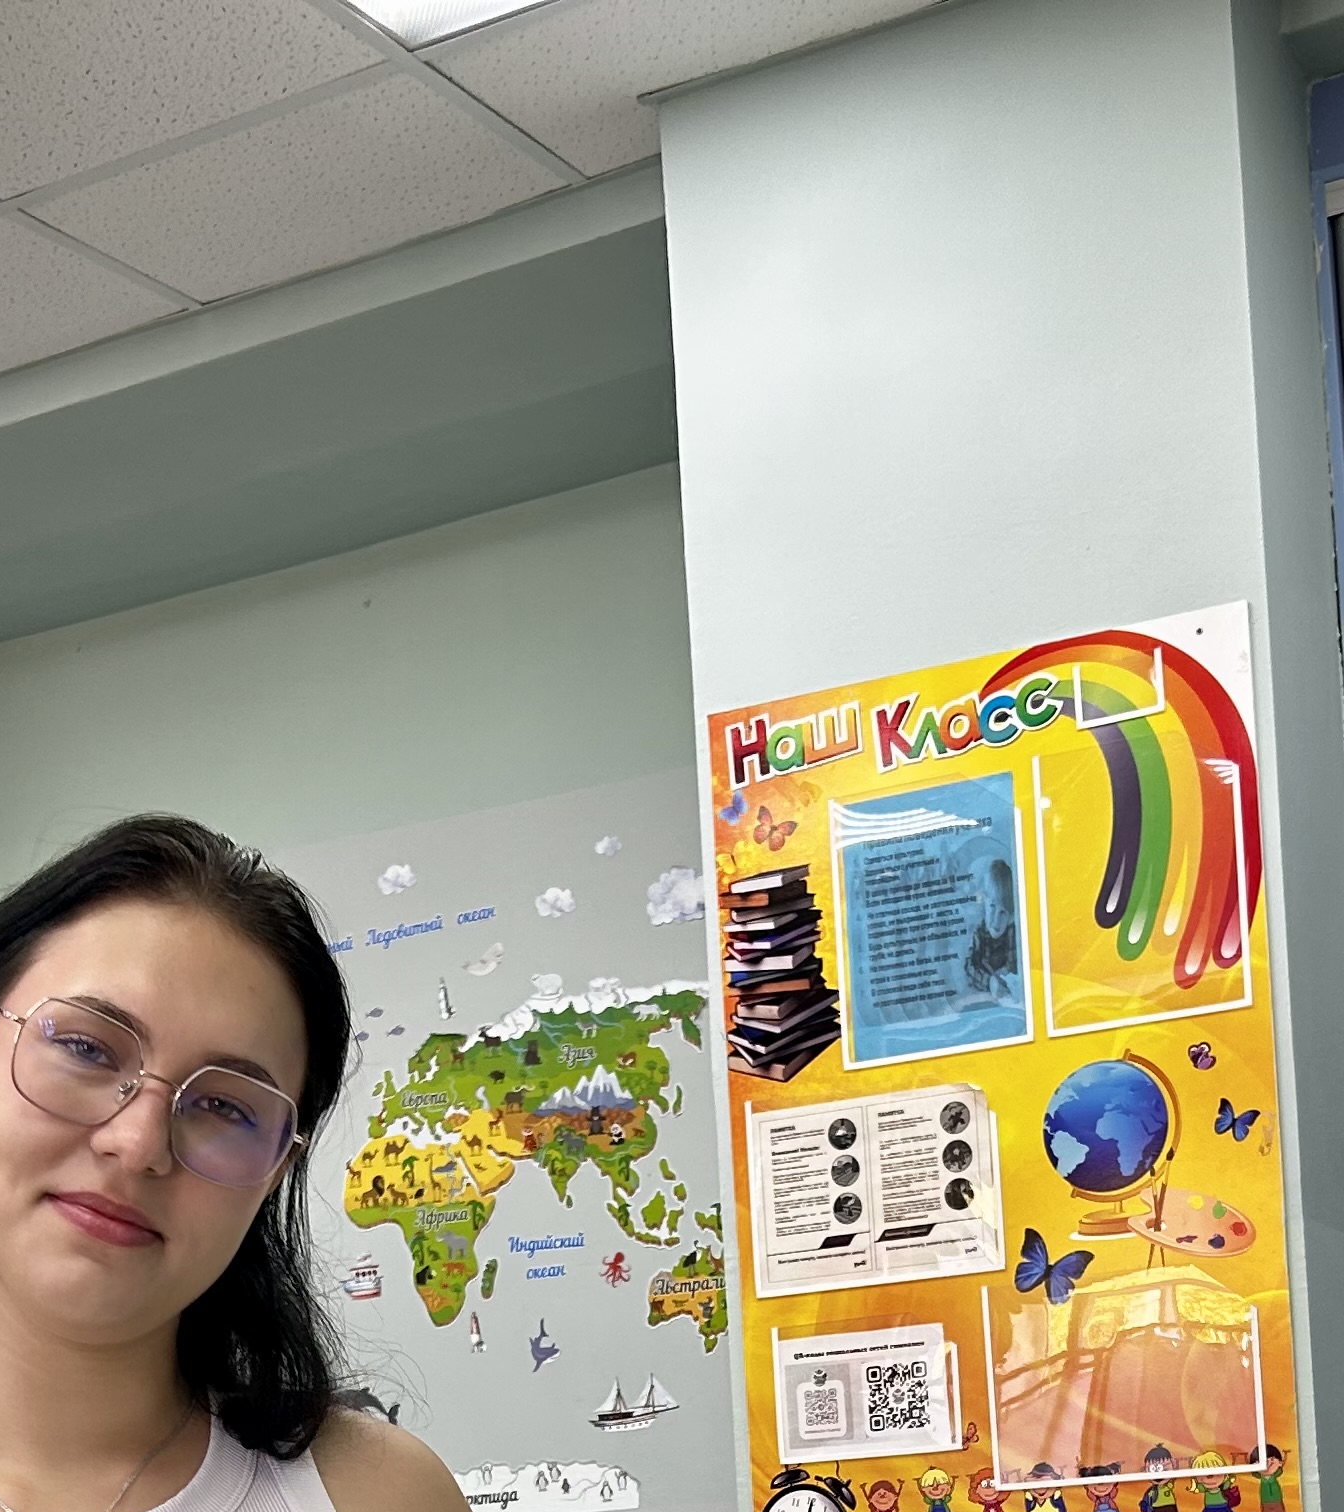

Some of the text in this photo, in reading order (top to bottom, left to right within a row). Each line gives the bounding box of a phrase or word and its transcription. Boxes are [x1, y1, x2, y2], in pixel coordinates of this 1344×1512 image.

[365, 914, 444, 950] Ледовитый
[456, 905, 497, 926] океан
[559, 1043, 596, 1068] Азия
[401, 1090, 447, 1113] Европа
[414, 1209, 469, 1231] Африка
[508, 1231, 586, 1259] Индийский
[526, 1264, 567, 1280] океан
